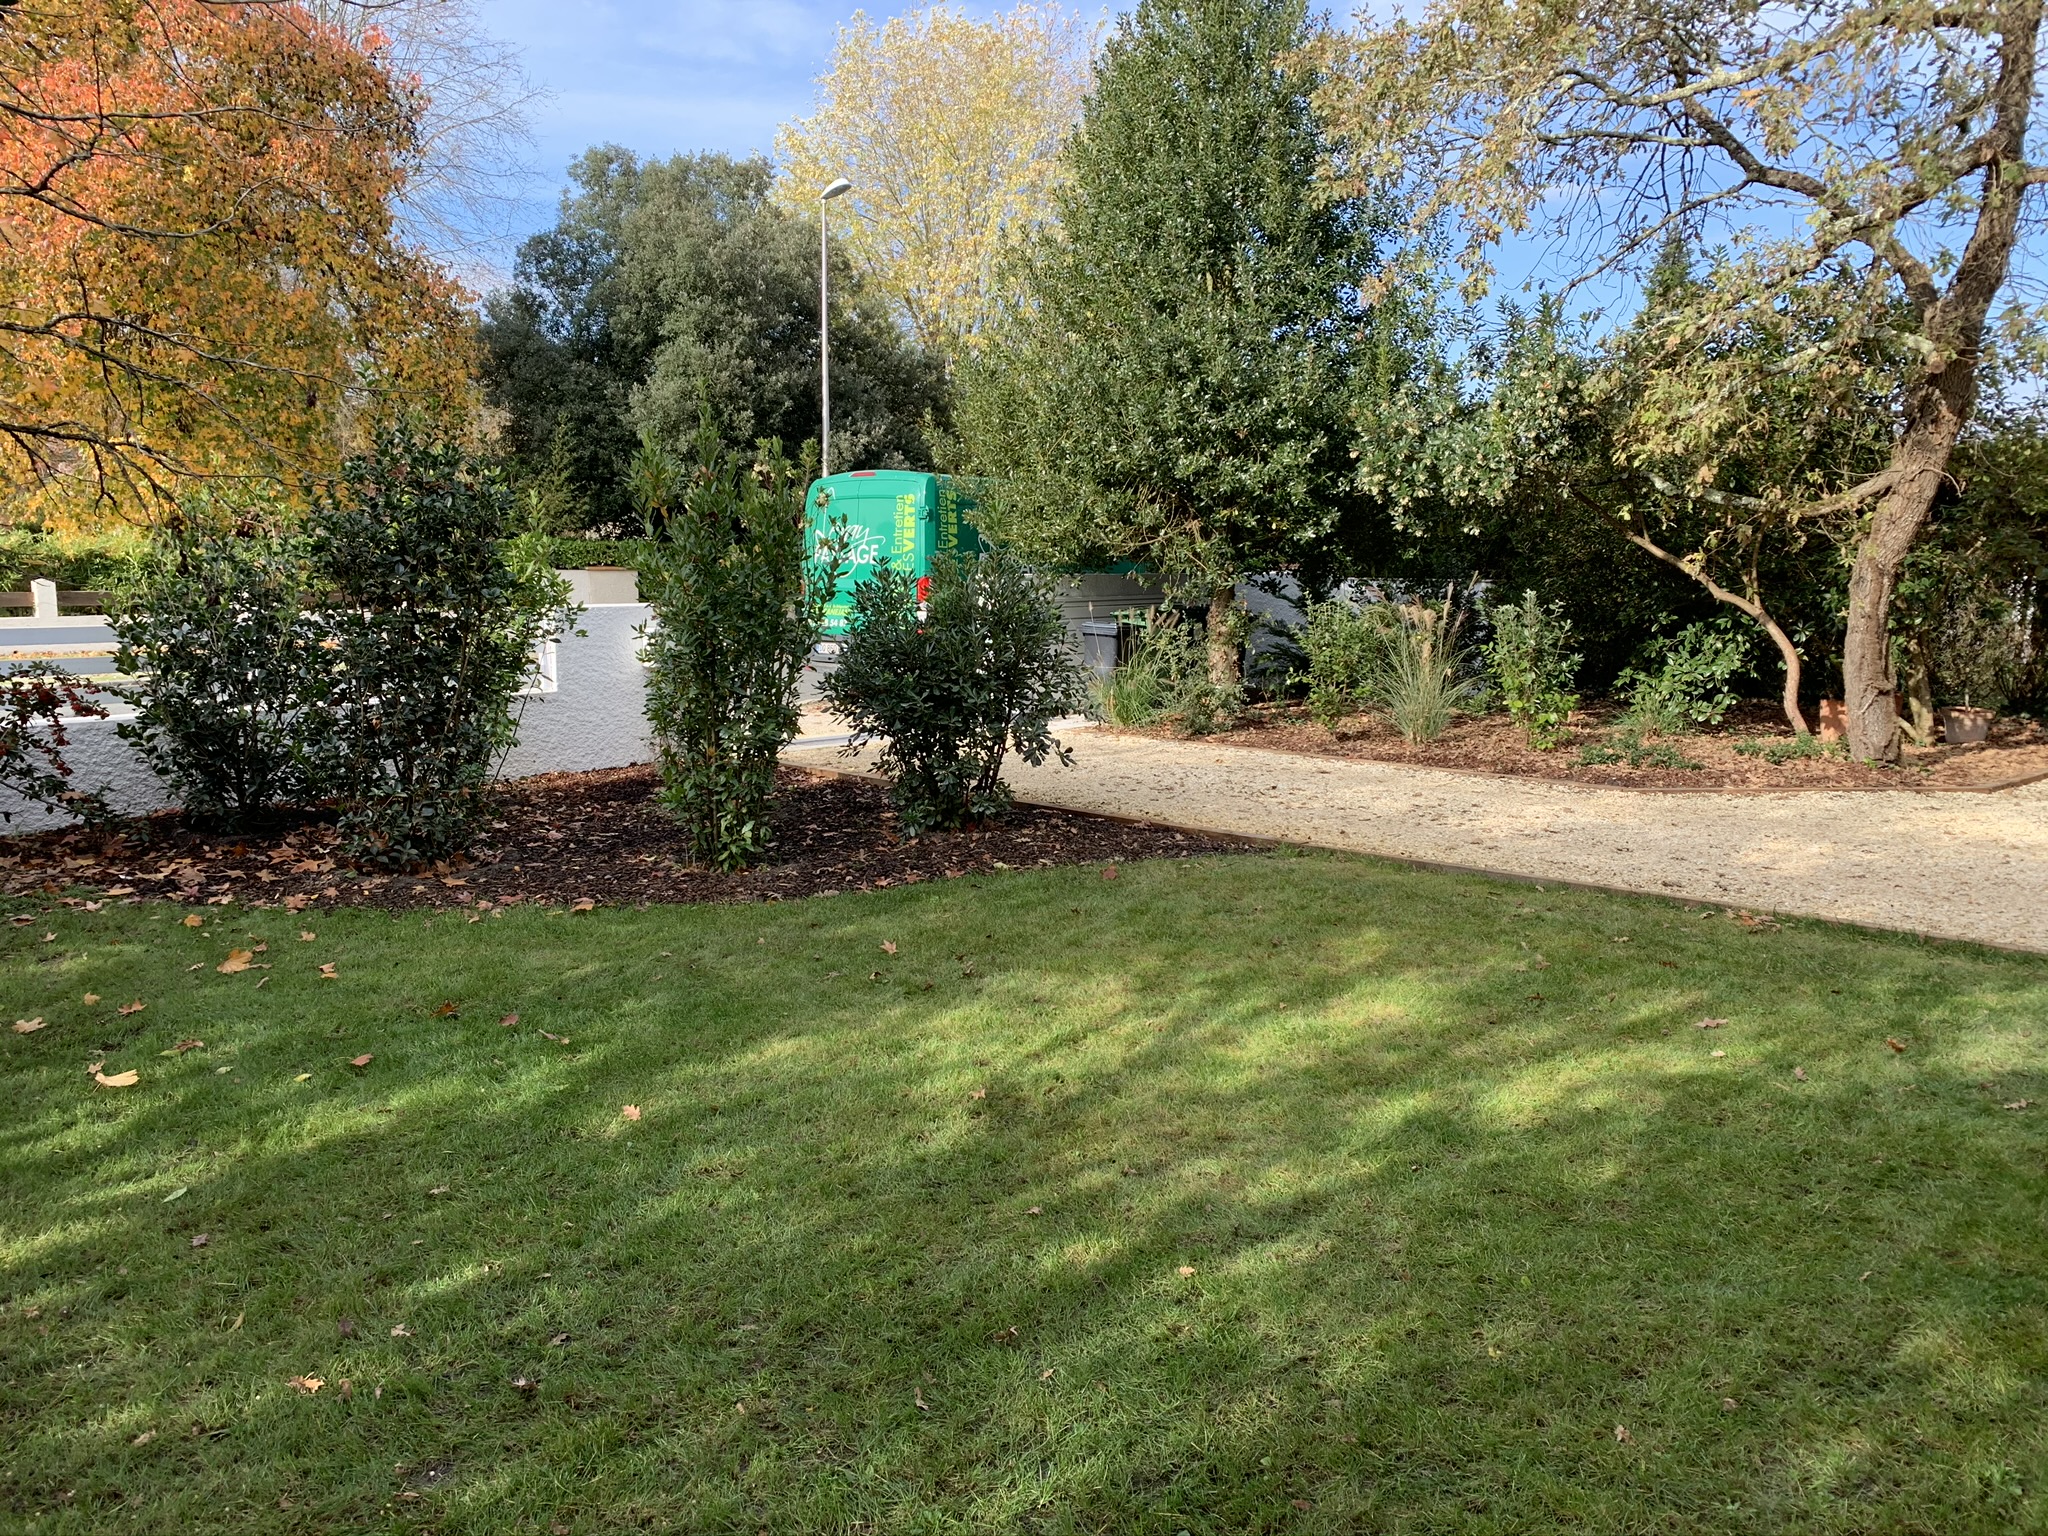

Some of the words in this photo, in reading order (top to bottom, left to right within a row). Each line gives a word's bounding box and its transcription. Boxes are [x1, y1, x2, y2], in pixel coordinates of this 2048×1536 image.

[891, 494, 904, 553] Entretien
[902, 493, 915, 553] VERTS
[937, 489, 948, 549] Entretien
[946, 489, 958, 548] VERTS
[891, 559, 902, 570] &
